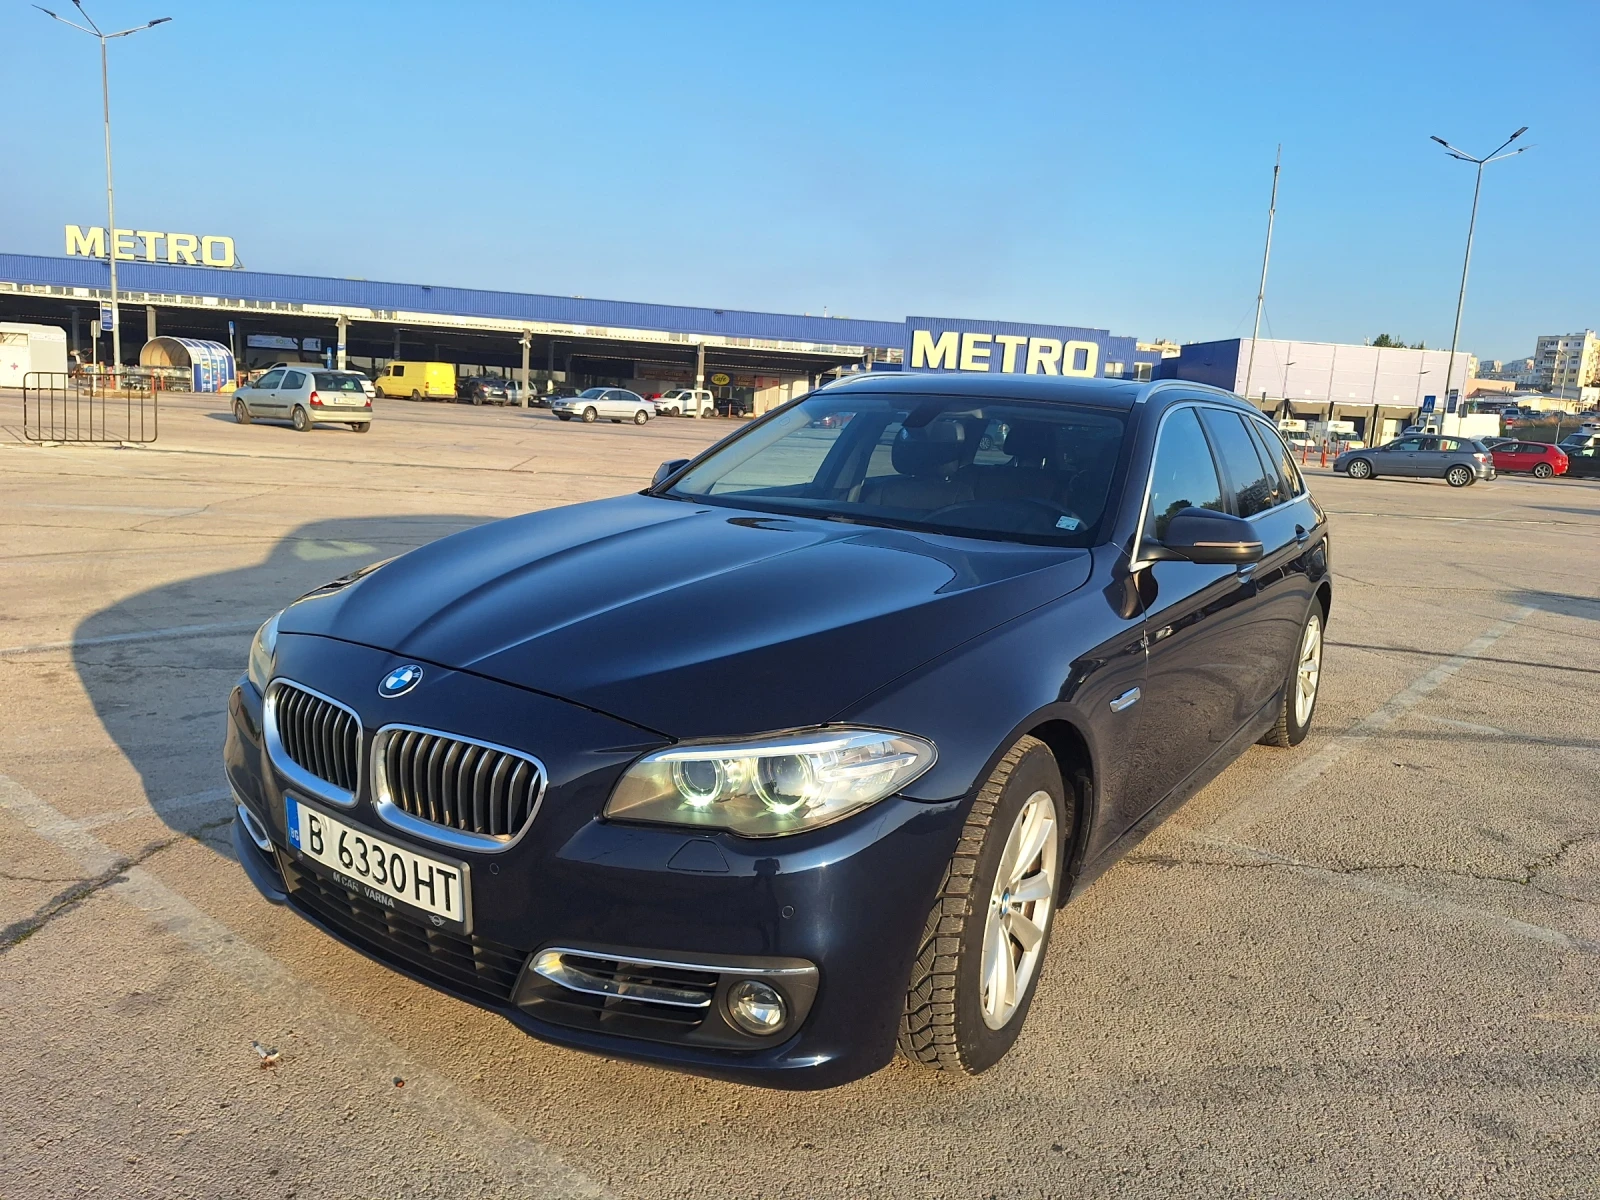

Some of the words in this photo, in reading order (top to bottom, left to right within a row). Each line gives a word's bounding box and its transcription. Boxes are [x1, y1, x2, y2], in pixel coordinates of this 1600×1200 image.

[65, 224, 235, 267] METRO
[911, 330, 1099, 378] METRO
[289, 827, 300, 841] BG
[308, 813, 324, 856] B
[338, 831, 407, 894] 6330
[413, 861, 457, 912] HT
[364, 886, 395, 908] VARNA
